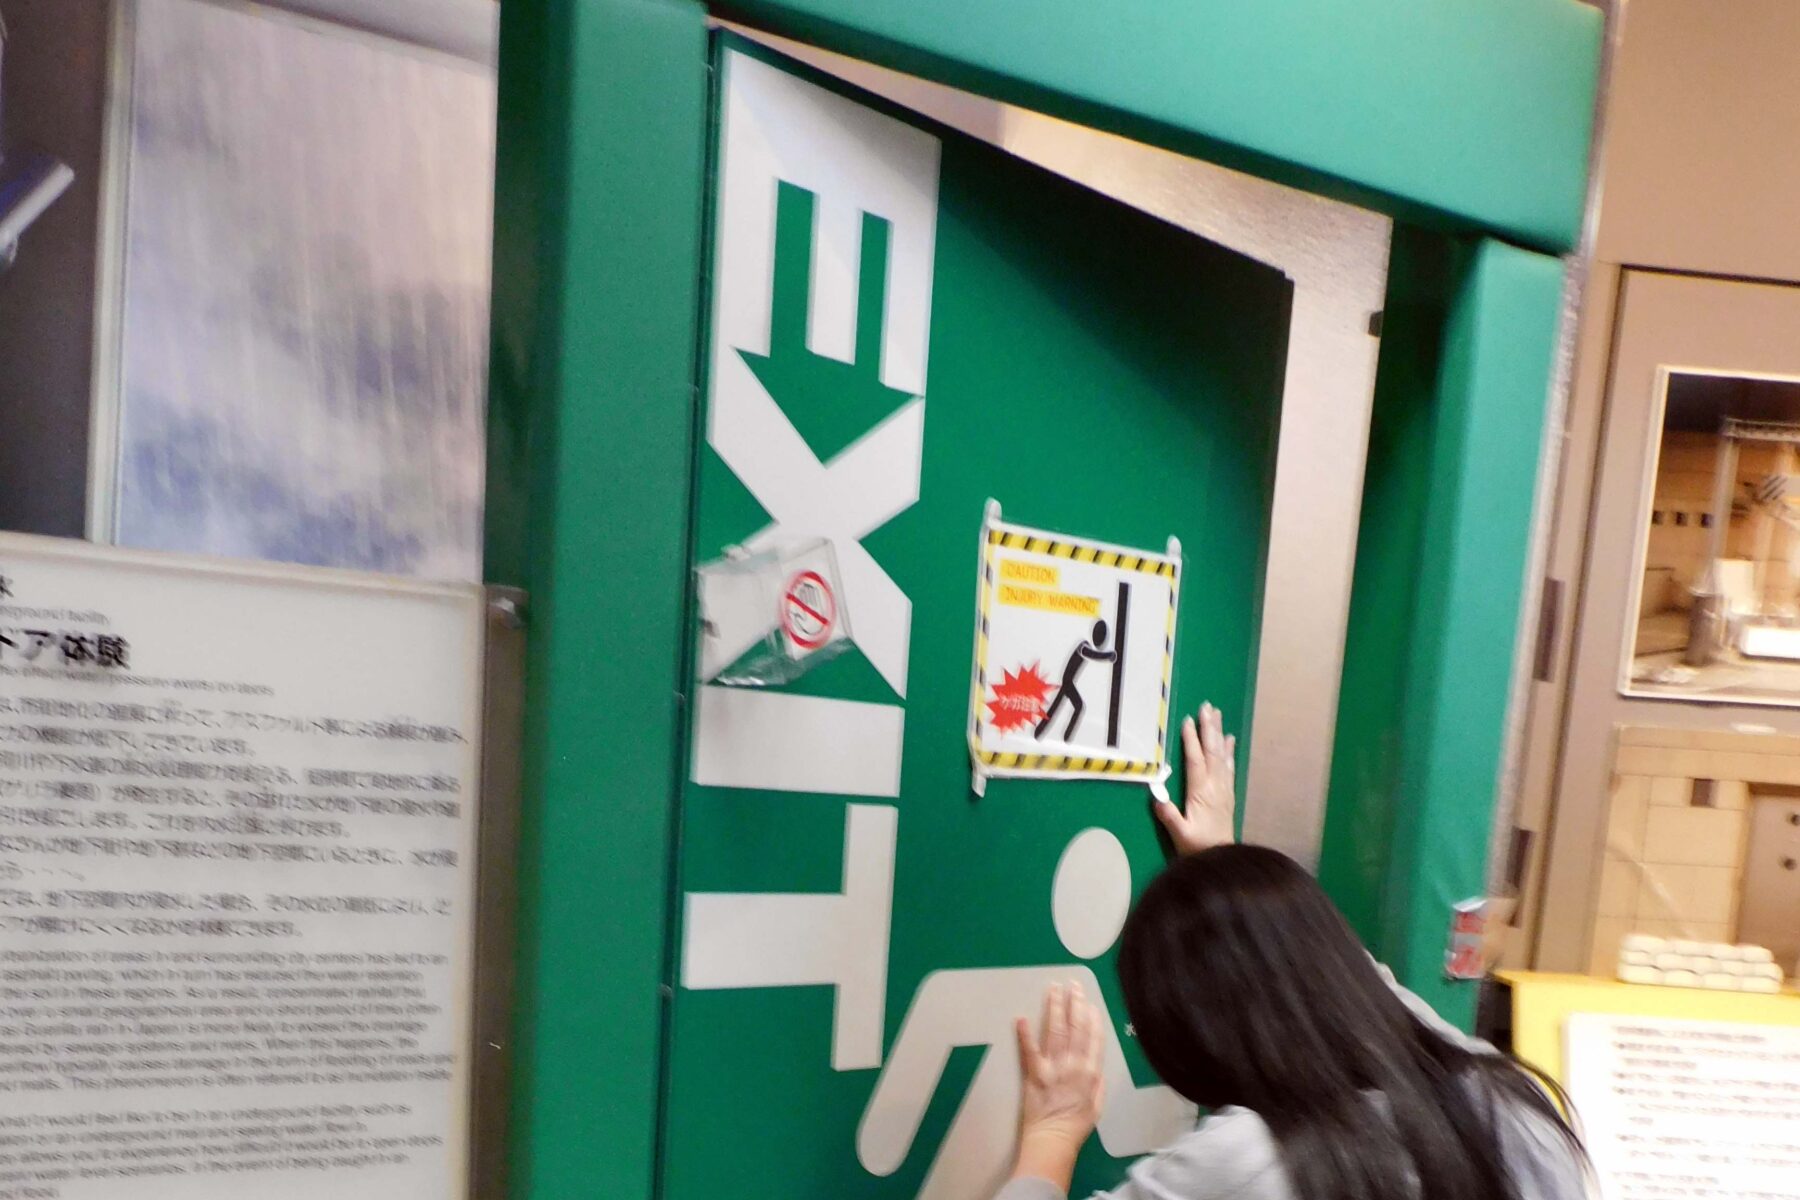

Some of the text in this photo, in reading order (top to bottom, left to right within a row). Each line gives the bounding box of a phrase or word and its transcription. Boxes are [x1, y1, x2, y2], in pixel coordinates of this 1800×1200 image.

[680, 47, 941, 1071] EXIT
[1006, 562, 1056, 584] CAUTION
[1005, 586, 1097, 614] INJURY WARNING
